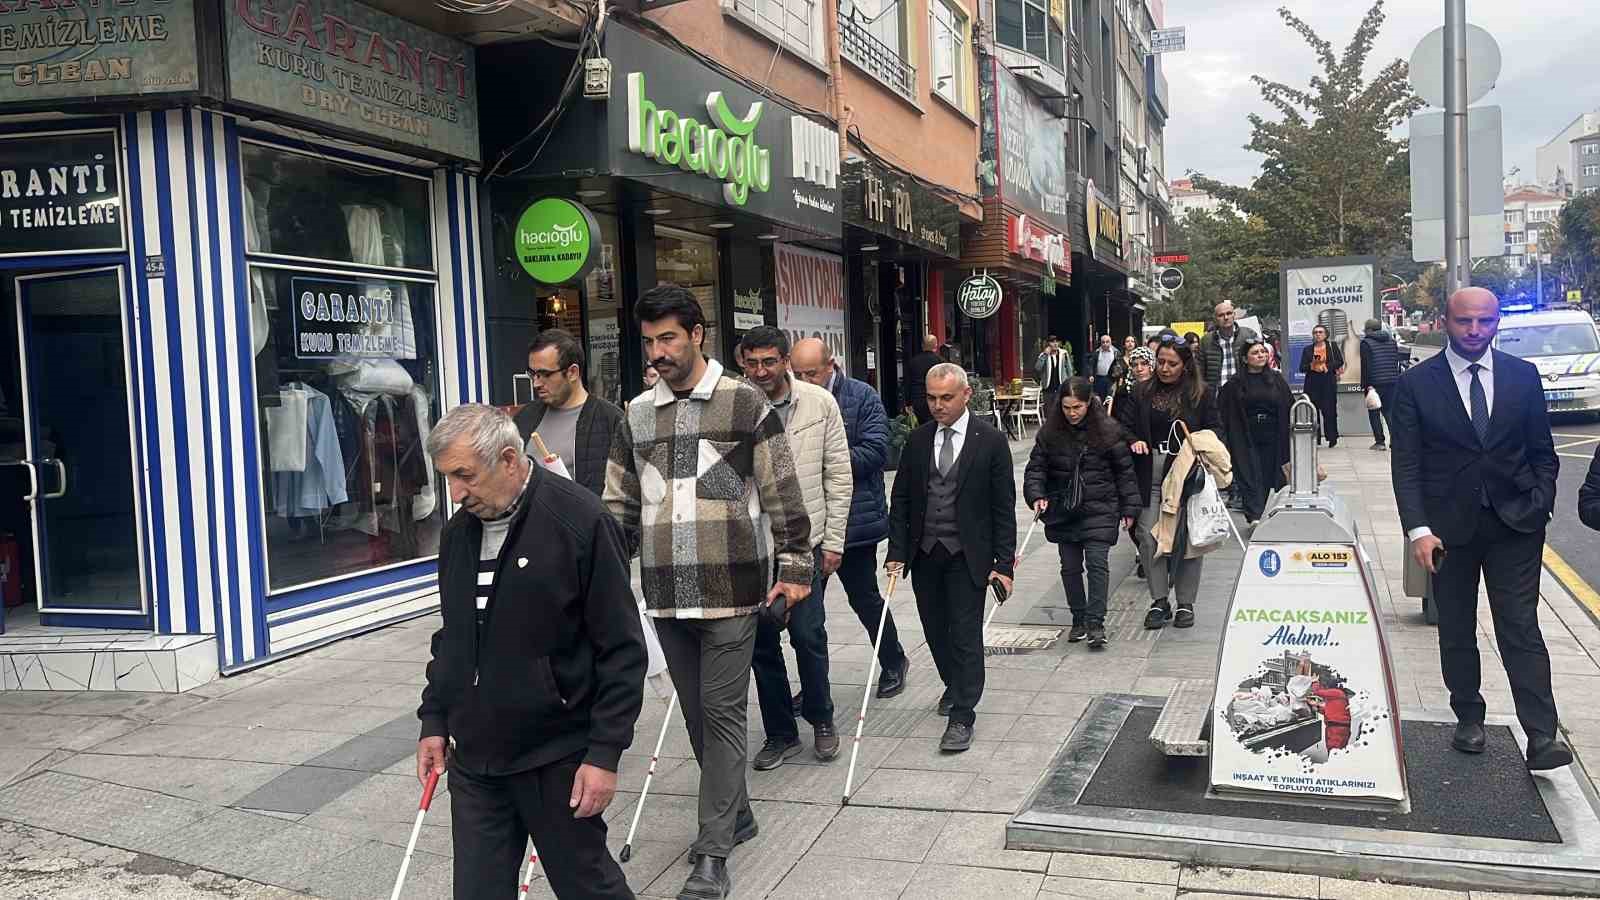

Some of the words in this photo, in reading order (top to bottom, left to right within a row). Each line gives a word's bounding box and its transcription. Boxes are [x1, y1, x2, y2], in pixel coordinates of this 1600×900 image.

[0, 15, 169, 49] EMİZLEME
[13, 57, 132, 86] CLEAN
[257, 41, 325, 81] KURU
[302, 84, 350, 113] DRY
[358, 103, 433, 138] CLEAN
[1, 154, 107, 198] RANTİ
[10, 201, 116, 228] TEMİZLEME
[961, 285, 996, 310] Hatay
[1297, 285, 1363, 296] REKLAMINIZ
[1297, 295, 1363, 306] KONUŞSUN!
[300, 332, 333, 352] KURU
[1311, 553, 1331, 561] ALO
[1333, 552, 1348, 561] 153
[1234, 608, 1369, 624] ATACAKSANIZ
[1267, 775, 1279, 783] VE
[1281, 776, 1314, 785] YIKINTI
[1316, 779, 1376, 789] ATIKLARINIZI
[1273, 783, 1334, 793] TOPLUYORUZ
